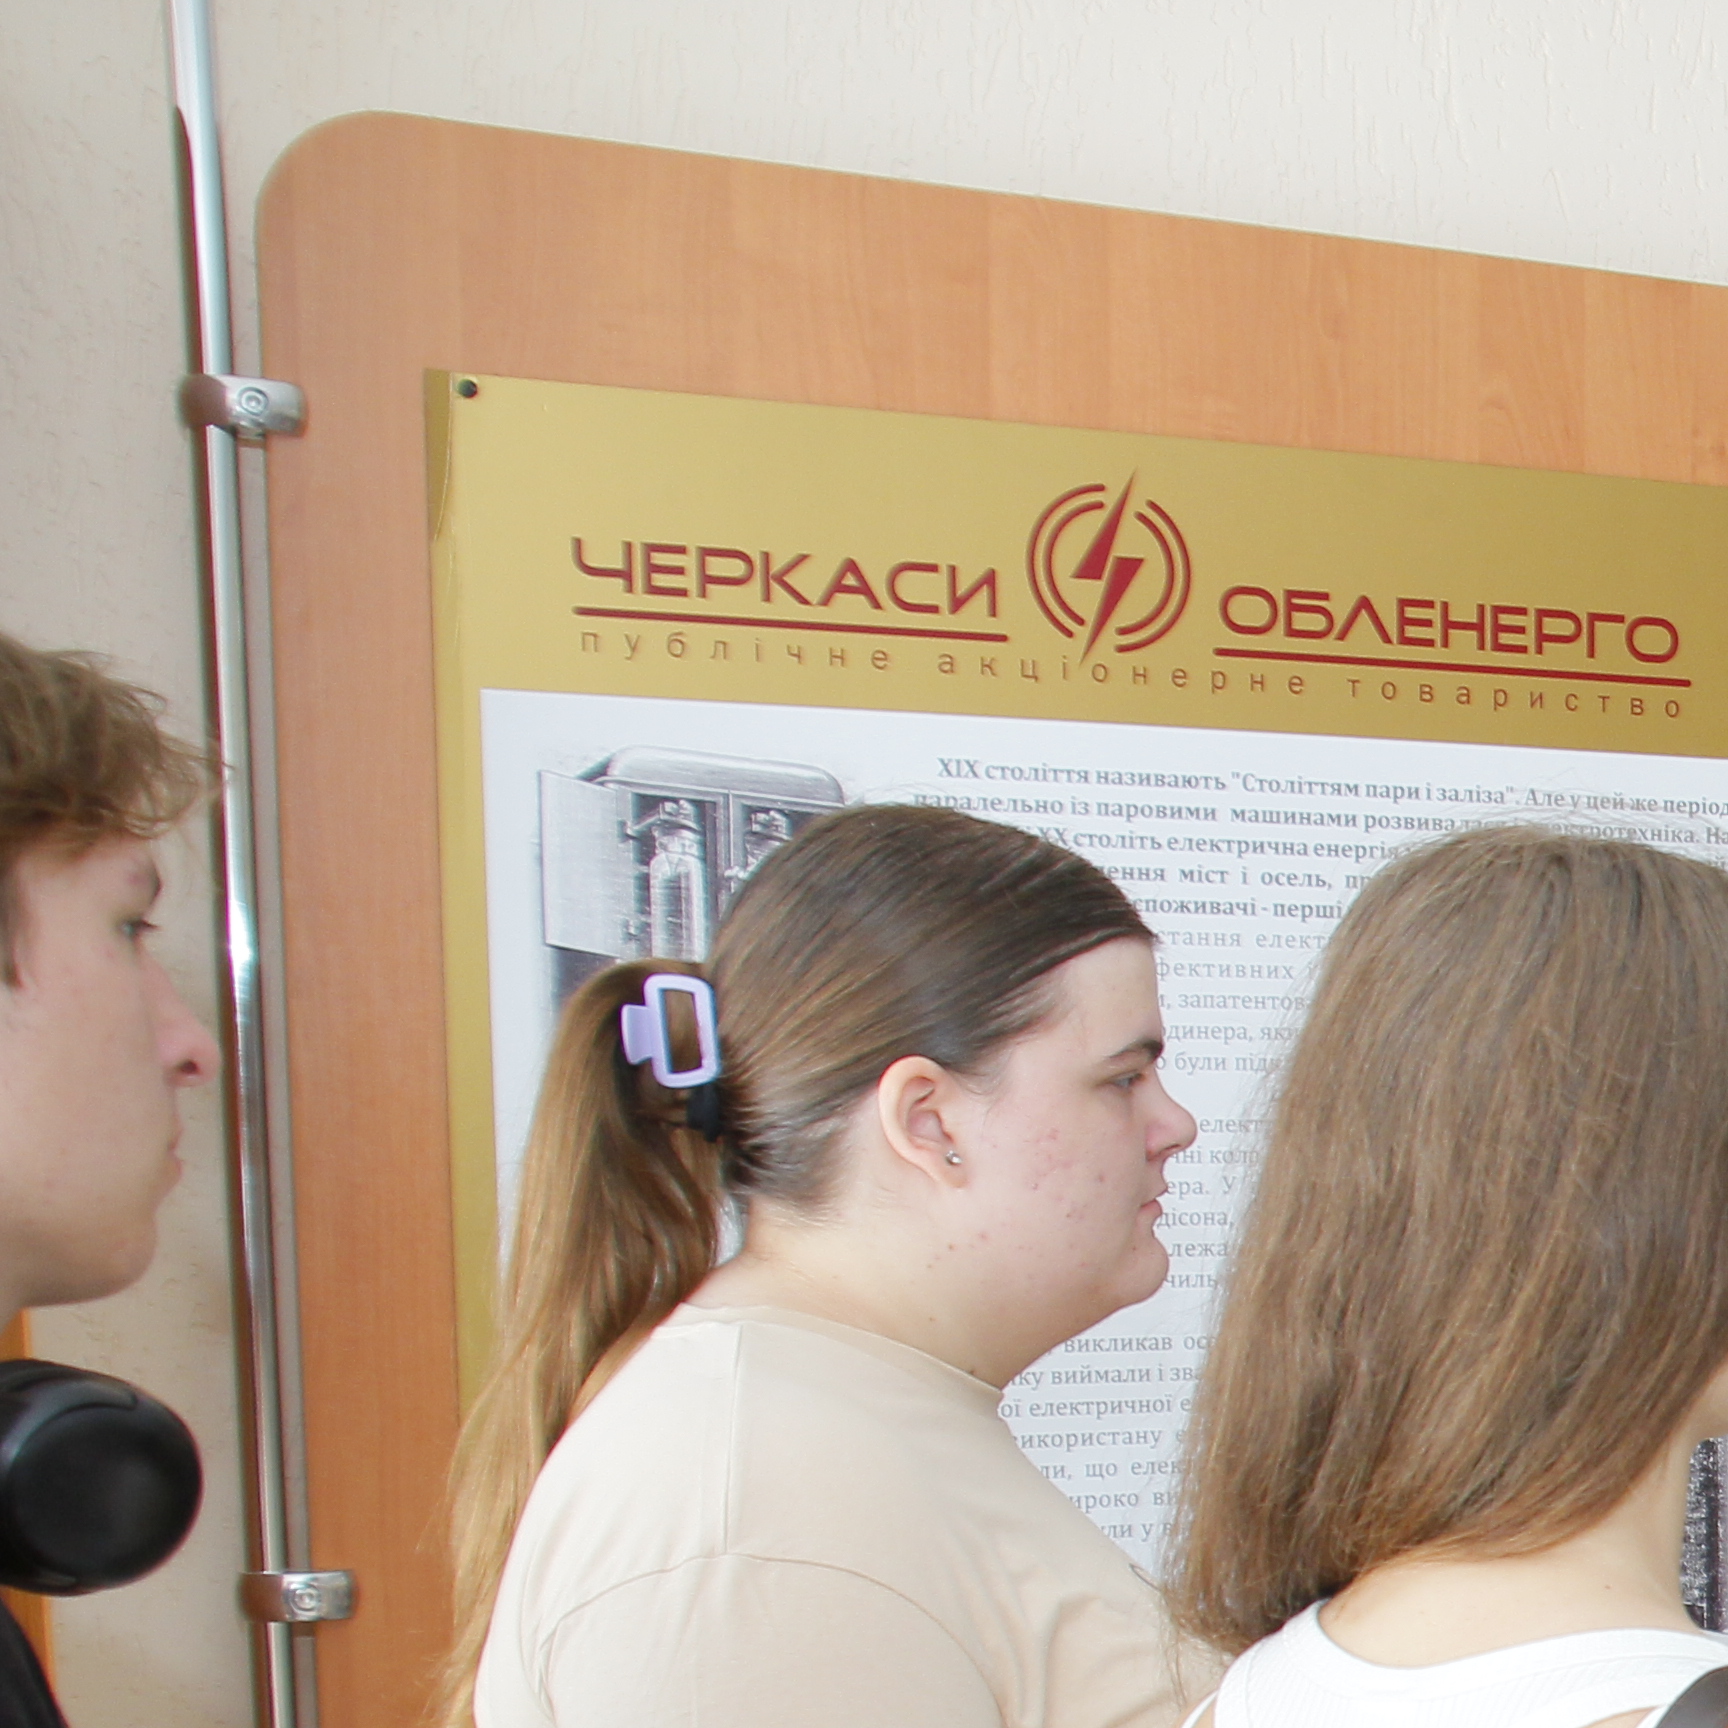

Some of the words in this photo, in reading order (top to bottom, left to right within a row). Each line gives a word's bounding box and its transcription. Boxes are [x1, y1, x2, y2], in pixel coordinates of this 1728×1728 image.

[571, 536, 998, 618] ЧЕРКАСИ
[1218, 585, 1680, 664] ОБЛЕНЕРГО
[580, 630, 890, 671] публічне
[937, 652, 1305, 696] акціонерне
[1347, 675, 1681, 719] товариство
[985, 761, 1090, 785] століття
[1096, 769, 1226, 791] називають
[1231, 771, 1359, 798] "Століттям
[1365, 783, 1422, 806] пари
[1525, 788, 1565, 807] Але
[1585, 792, 1625, 812] цей
[1630, 796, 1658, 812] же
[1070, 796, 1090, 816] із
[1096, 802, 1217, 827] паровими
[1229, 808, 1358, 829] машинами
[1073, 828, 1162, 851] століть
[1167, 835, 1311, 858] електрична
[1178, 866, 1230, 884] міст
[1260, 871, 1334, 891] осель,
[1272, 901, 1343, 923] перші
[1178, 992, 1309, 1011] запатентов
[1162, 1024, 1253, 1045] динера,
[1174, 1051, 1227, 1076] були
[1063, 1335, 1172, 1353] викликав
[1050, 1364, 1151, 1385] виймали
[1029, 1395, 1172, 1420] електричної
[1085, 1462, 1118, 1480] що
